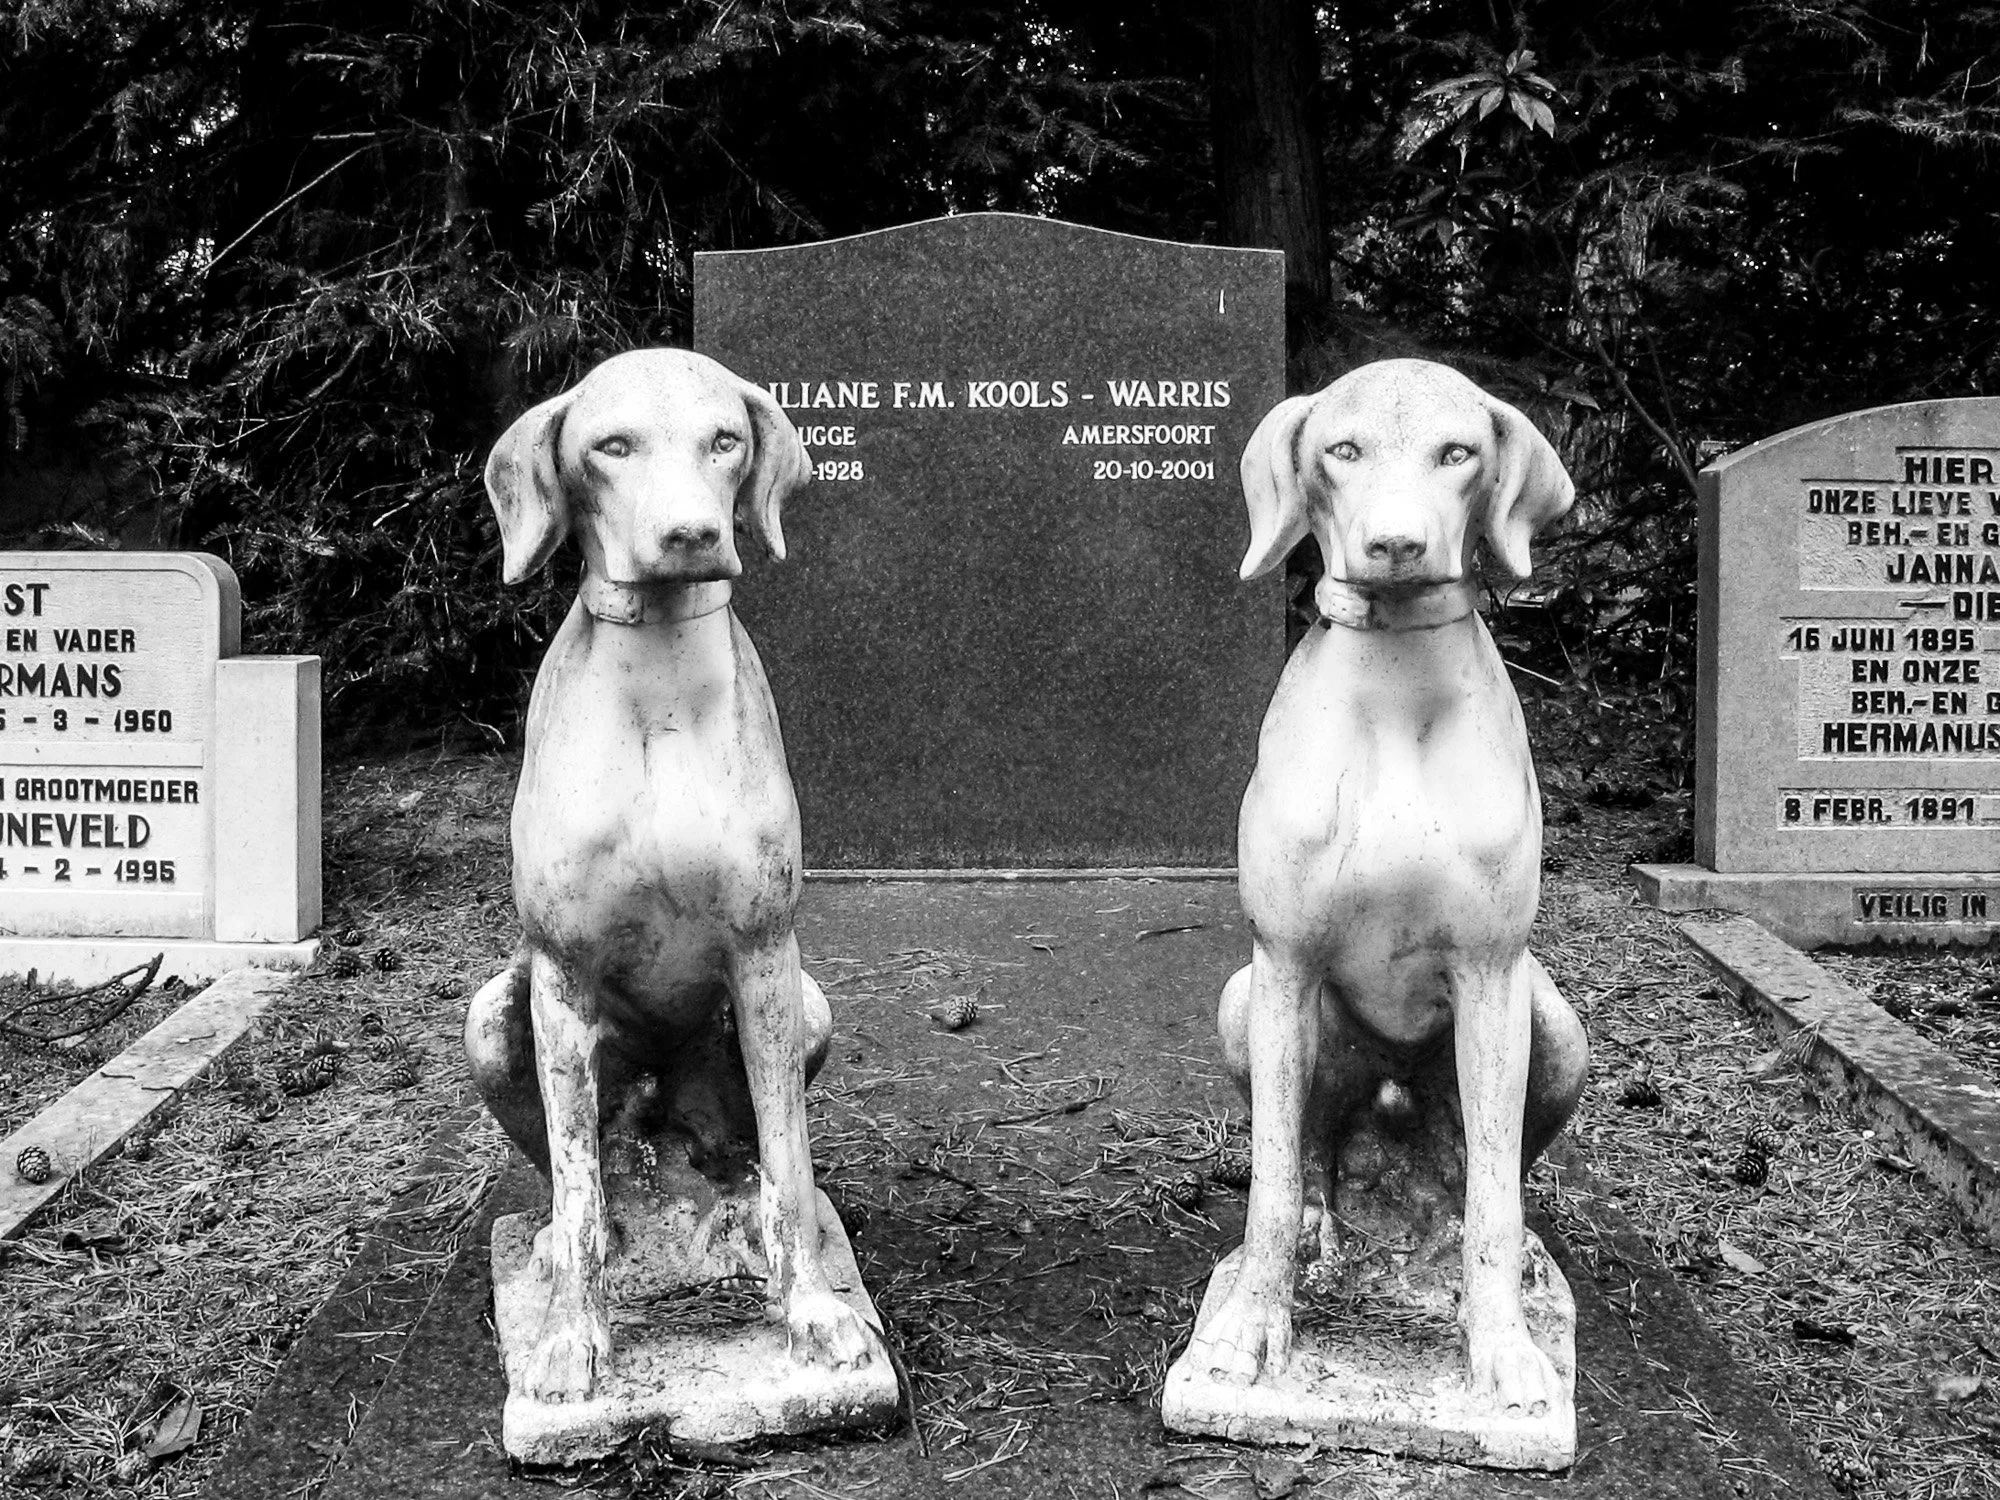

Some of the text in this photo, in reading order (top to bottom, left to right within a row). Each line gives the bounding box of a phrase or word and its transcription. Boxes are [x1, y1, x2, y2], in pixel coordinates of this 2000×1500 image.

[768, 381, 881, 409] ILIANE
[892, 381, 955, 409] F.M.
[967, 380, 1069, 409] KOOLS
[1106, 379, 1231, 408] WARRIS
[797, 425, 857, 446] UGGE
[1062, 424, 1216, 445] AMERSFOORT
[811, 460, 865, 481] -1928
[1093, 459, 1216, 480] 20-10-2001
[1905, 456, 1995, 484] HIER
[1809, 489, 1876, 514] ONZE
[1891, 491, 1972, 516] LIEVE
[7, 628, 136, 653] EN VADER
[1788, 627, 1975, 652] 16 JUNI 1895
[1852, 659, 1981, 684] EN ONZE
[53, 708, 68, 732] 3
[113, 709, 173, 733] 1960
[15, 778, 200, 804] GROOTMOEDER
[1784, 797, 1974, 822] 8 FEBR. 1891
[0, 812, 151, 849] NEVELD
[54, 858, 71, 883] 2
[114, 859, 176, 883] 1995
[1859, 893, 1987, 918] VEILIG IN
